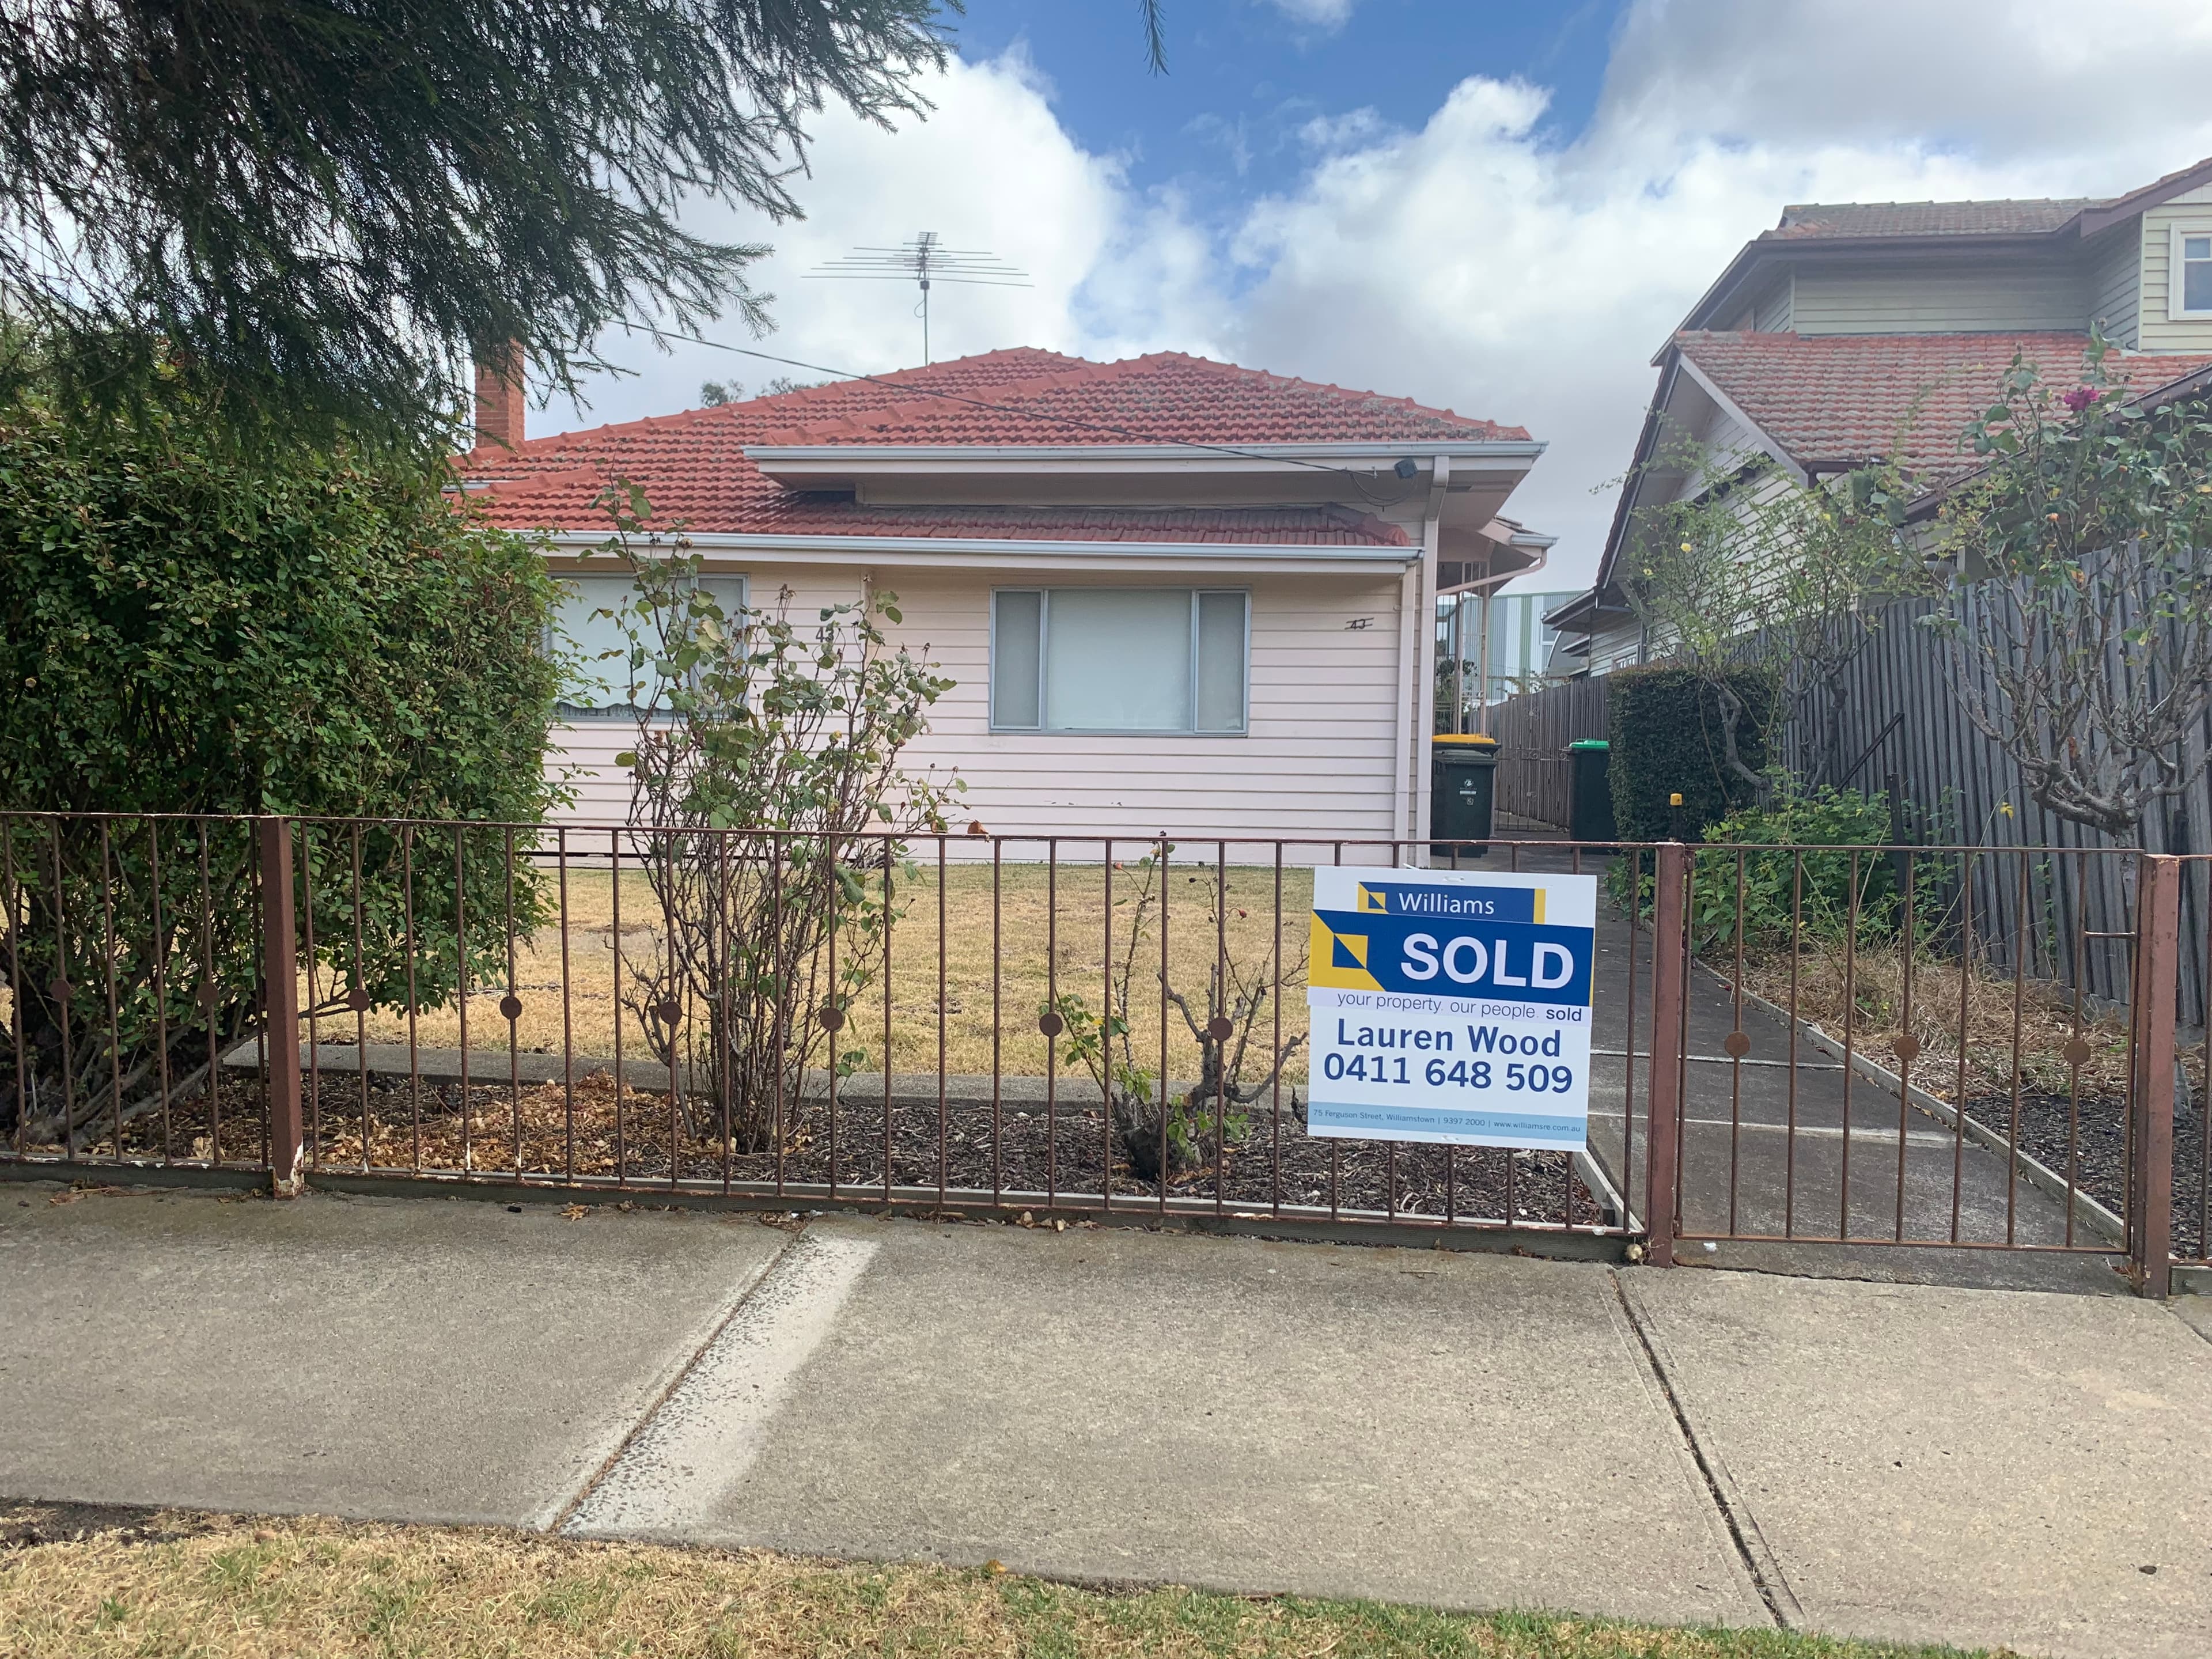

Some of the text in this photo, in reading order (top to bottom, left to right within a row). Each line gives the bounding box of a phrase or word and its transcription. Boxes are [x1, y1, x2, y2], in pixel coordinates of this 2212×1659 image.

[1399, 892, 1495, 915] Williams
[1400, 933, 1574, 989] SOLD
[1338, 993, 1372, 1006] your
[1450, 1001, 1476, 1013] our
[1546, 1007, 1582, 1021] sold
[1338, 1018, 1560, 1057] Lauren Wood
[1324, 1052, 1573, 1093] 0411 648 509
[1325, 1110, 1358, 1119] Ferguson
[1359, 1112, 1384, 1120] Street,
[1386, 1113, 1435, 1123] Williamstown
[1465, 1118, 1486, 1126] 2000
